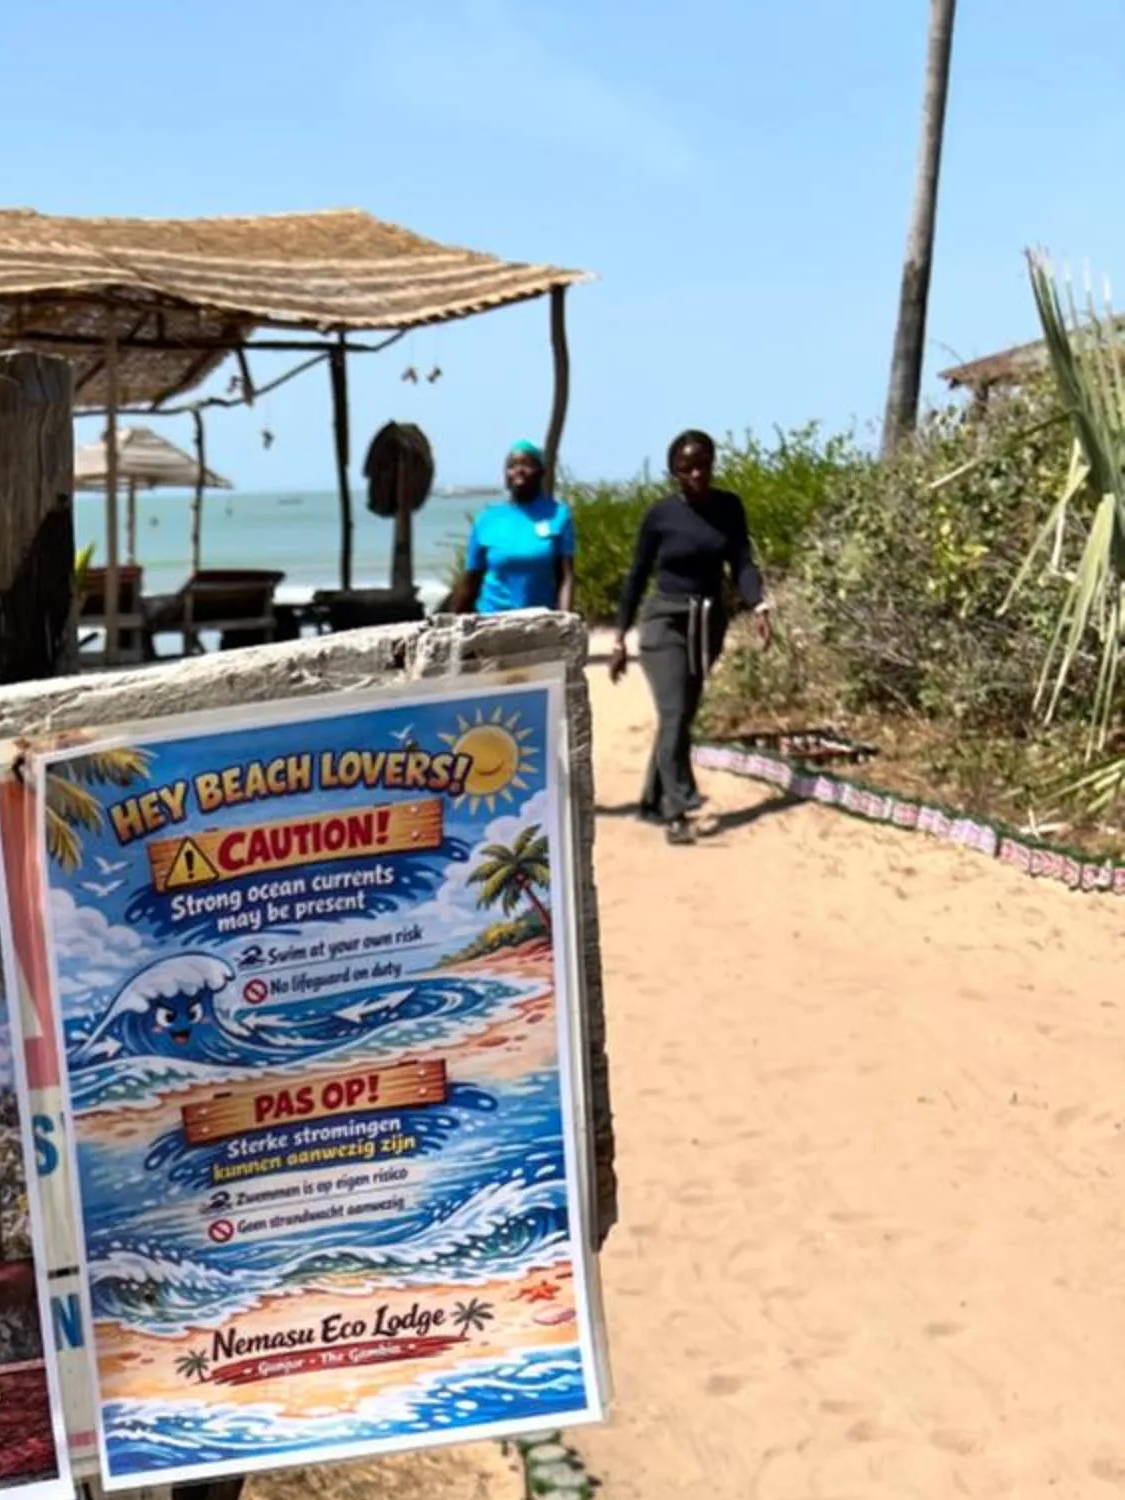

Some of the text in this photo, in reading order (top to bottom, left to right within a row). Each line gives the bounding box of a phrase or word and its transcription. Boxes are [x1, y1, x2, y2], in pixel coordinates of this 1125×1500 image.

[111, 751, 472, 844] HEY BEACH LOVERS!
[217, 810, 391, 873] CAUTION!
[171, 864, 394, 923] Strong ocean currents
[217, 891, 366, 934] may be present
[268, 924, 423, 964] Swim at your own risk
[270, 962, 402, 995] No lifeguard on duty
[254, 1074, 380, 1122] PAS OP!
[213, 1133, 417, 1182] kunnen aanwezig zijn
[227, 1114, 402, 1158] Sterke stromingen
[303, 1180, 314, 1195] is
[317, 1180, 332, 1194] op
[336, 1173, 370, 1191] eigen
[373, 1167, 408, 1183] risico
[237, 1219, 267, 1234] Geen
[210, 1303, 446, 1364] Nemasu Eco Lodge
[320, 1352, 344, 1365] The
